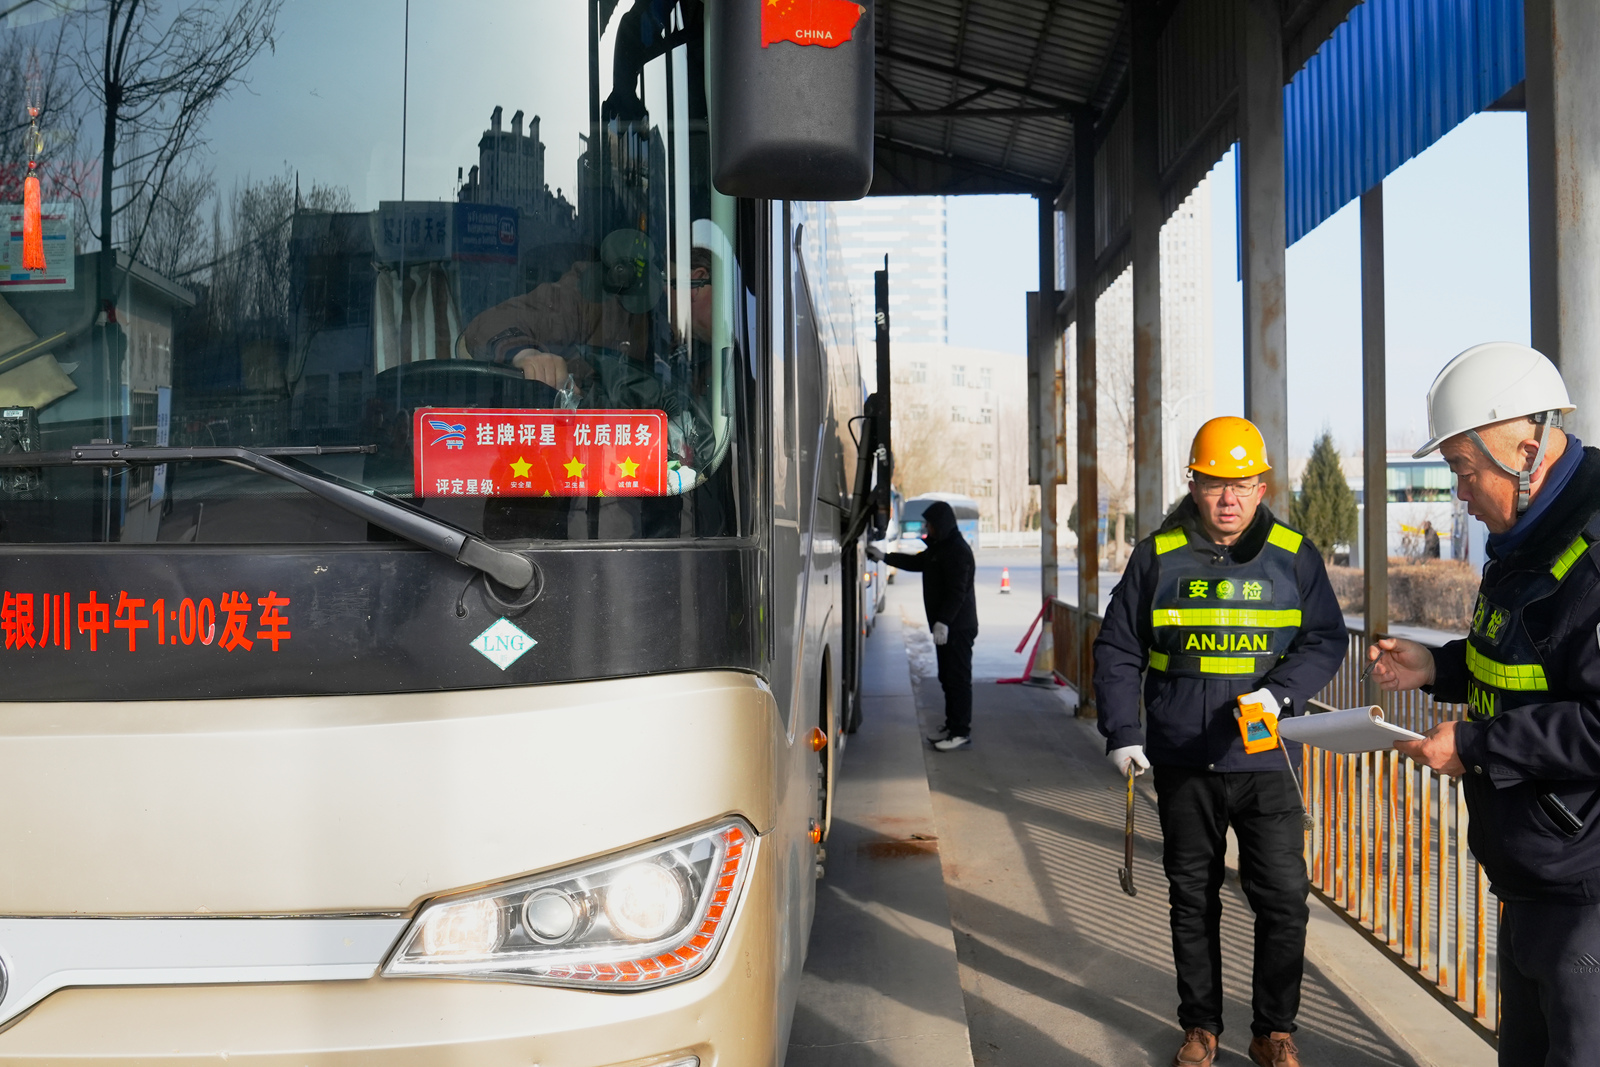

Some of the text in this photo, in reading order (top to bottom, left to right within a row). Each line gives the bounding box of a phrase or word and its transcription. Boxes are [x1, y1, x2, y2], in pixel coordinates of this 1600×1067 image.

[795, 29, 833, 40] CHINA
[476, 422, 557, 446] 挂牌评星
[573, 422, 653, 446] 优质服务
[435, 478, 500, 495] 评定星级：
[510, 481, 532, 489] 安全星
[564, 481, 586, 489] 卫生星
[617, 480, 639, 488] 诚信星
[1, 589, 291, 652] 银川中午1:00发车
[482, 634, 525, 652] LNG
[1185, 633, 1268, 652] ANJIAN
